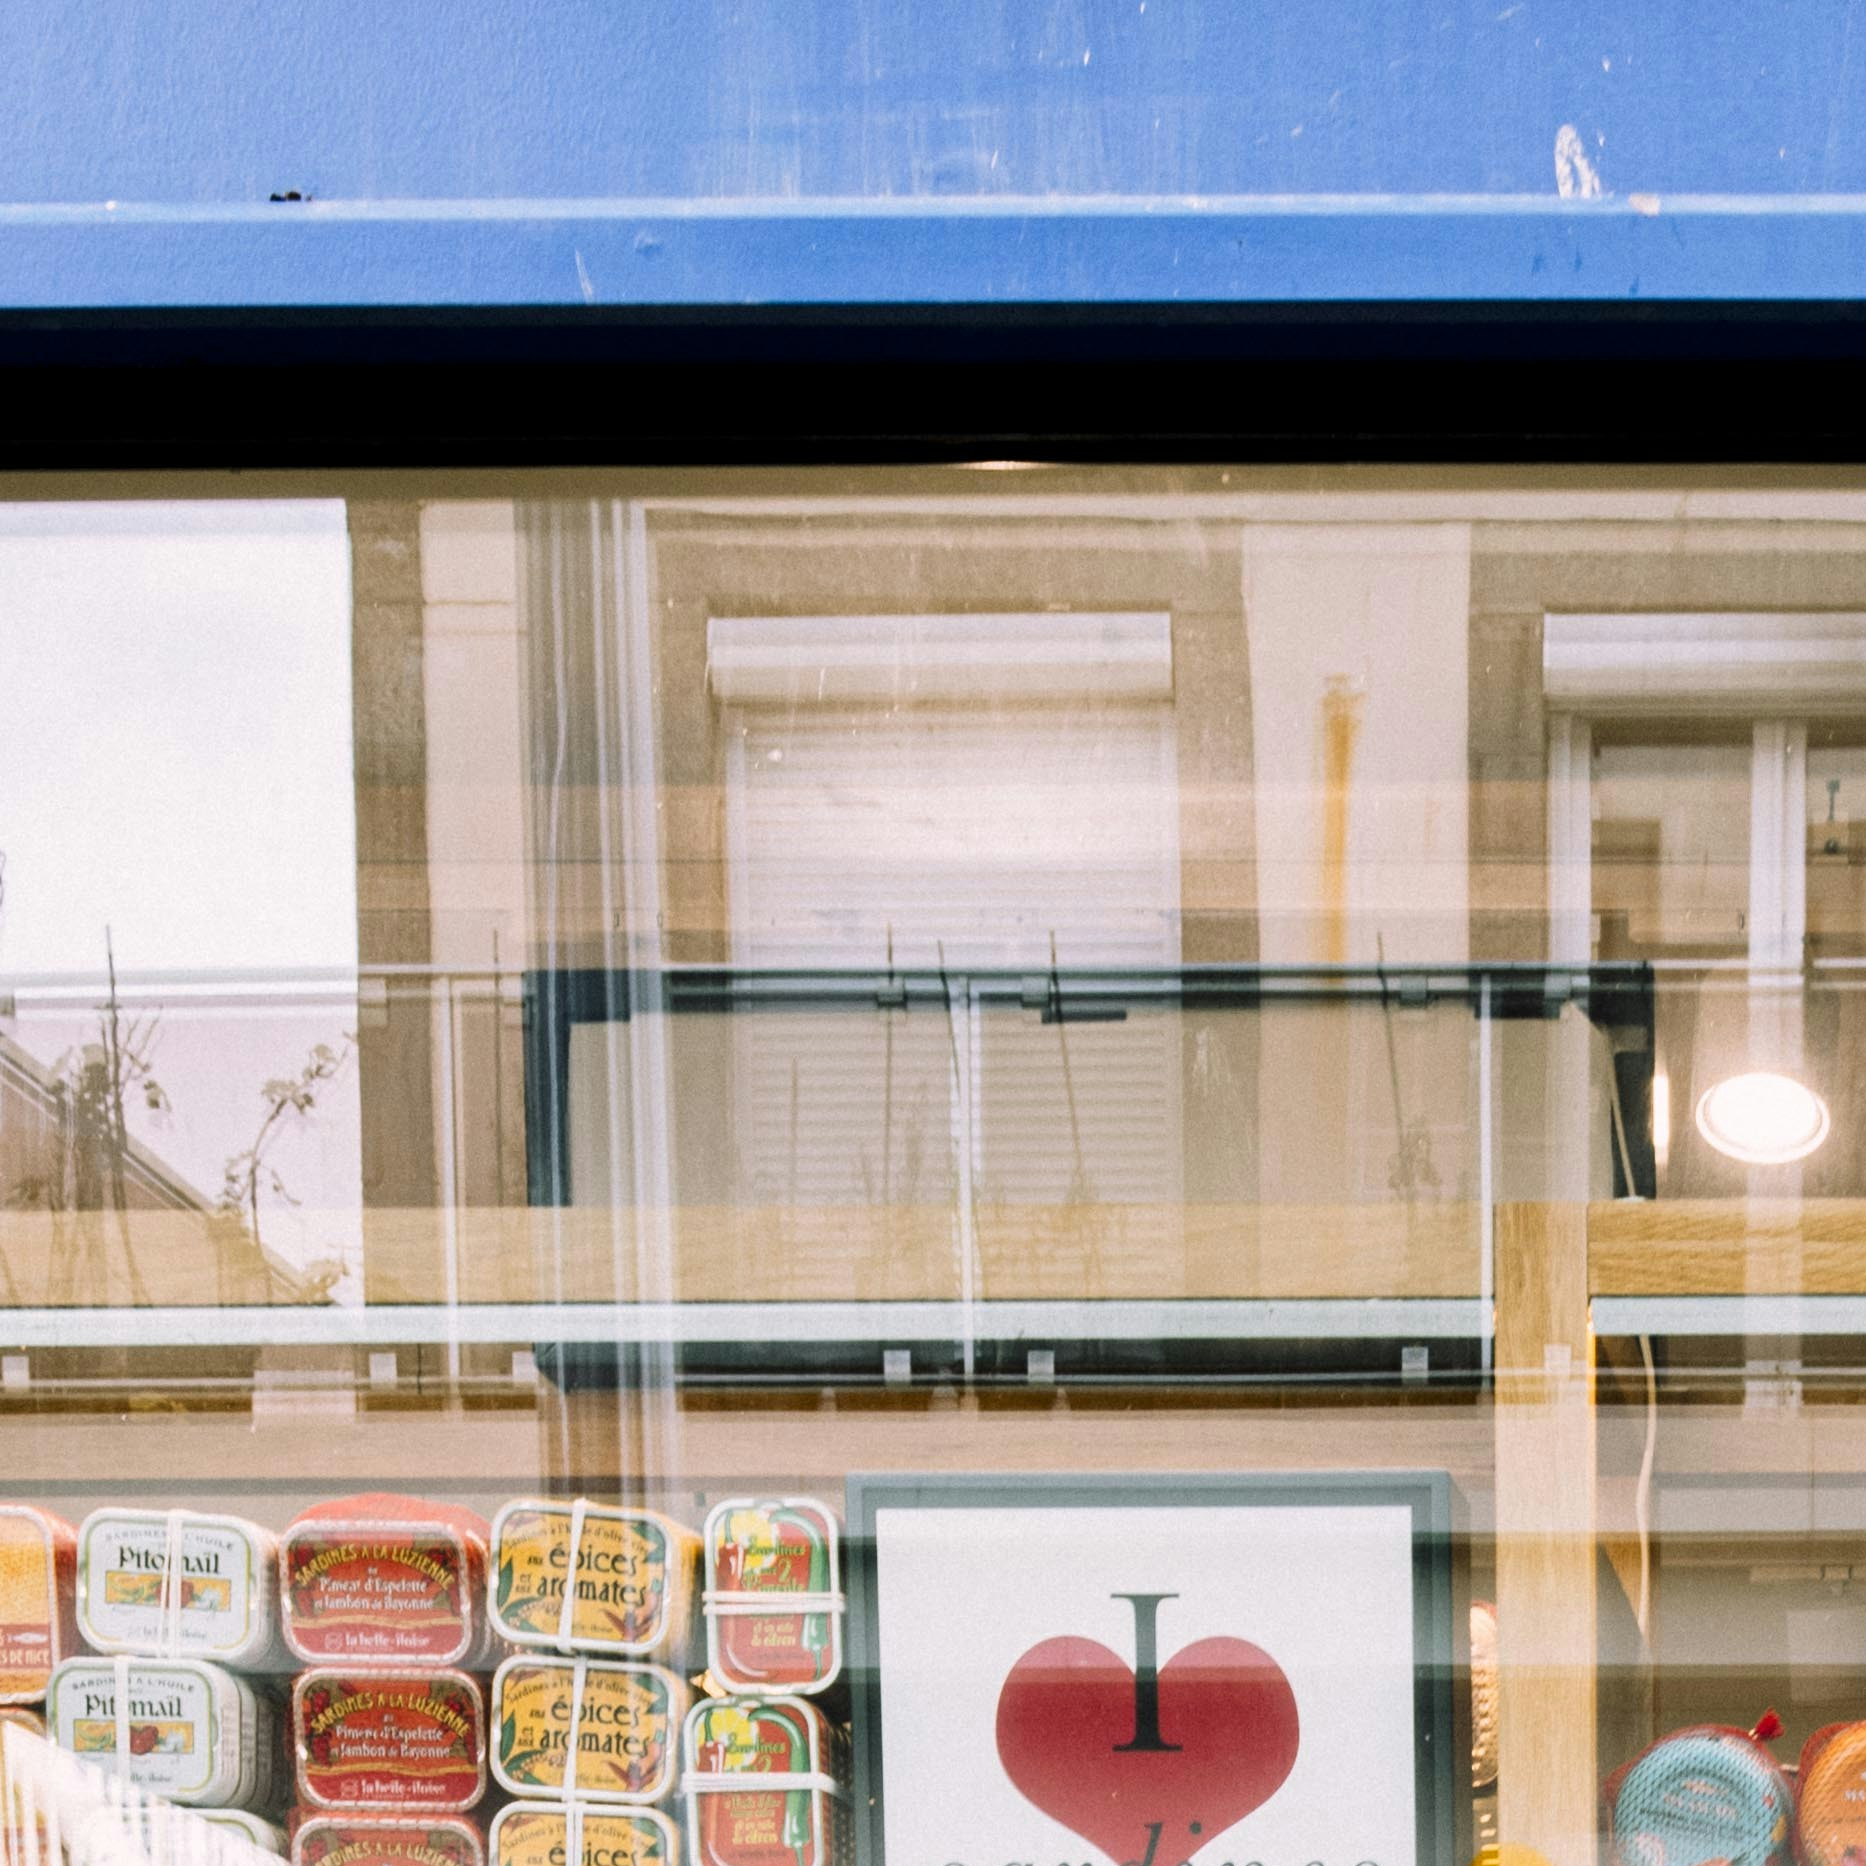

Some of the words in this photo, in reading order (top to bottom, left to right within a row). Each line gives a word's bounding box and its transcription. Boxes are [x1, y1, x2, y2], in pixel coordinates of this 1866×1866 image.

[295, 1544, 357, 1586] SARDINES
[391, 1548, 455, 1590] LUZIENNE
[1110, 1594, 1182, 1752] I
[86, 1694, 183, 1717] Pitmaïl
[311, 1693, 374, 1733] SARDINES
[408, 1695, 471, 1737] LUZIENNE
